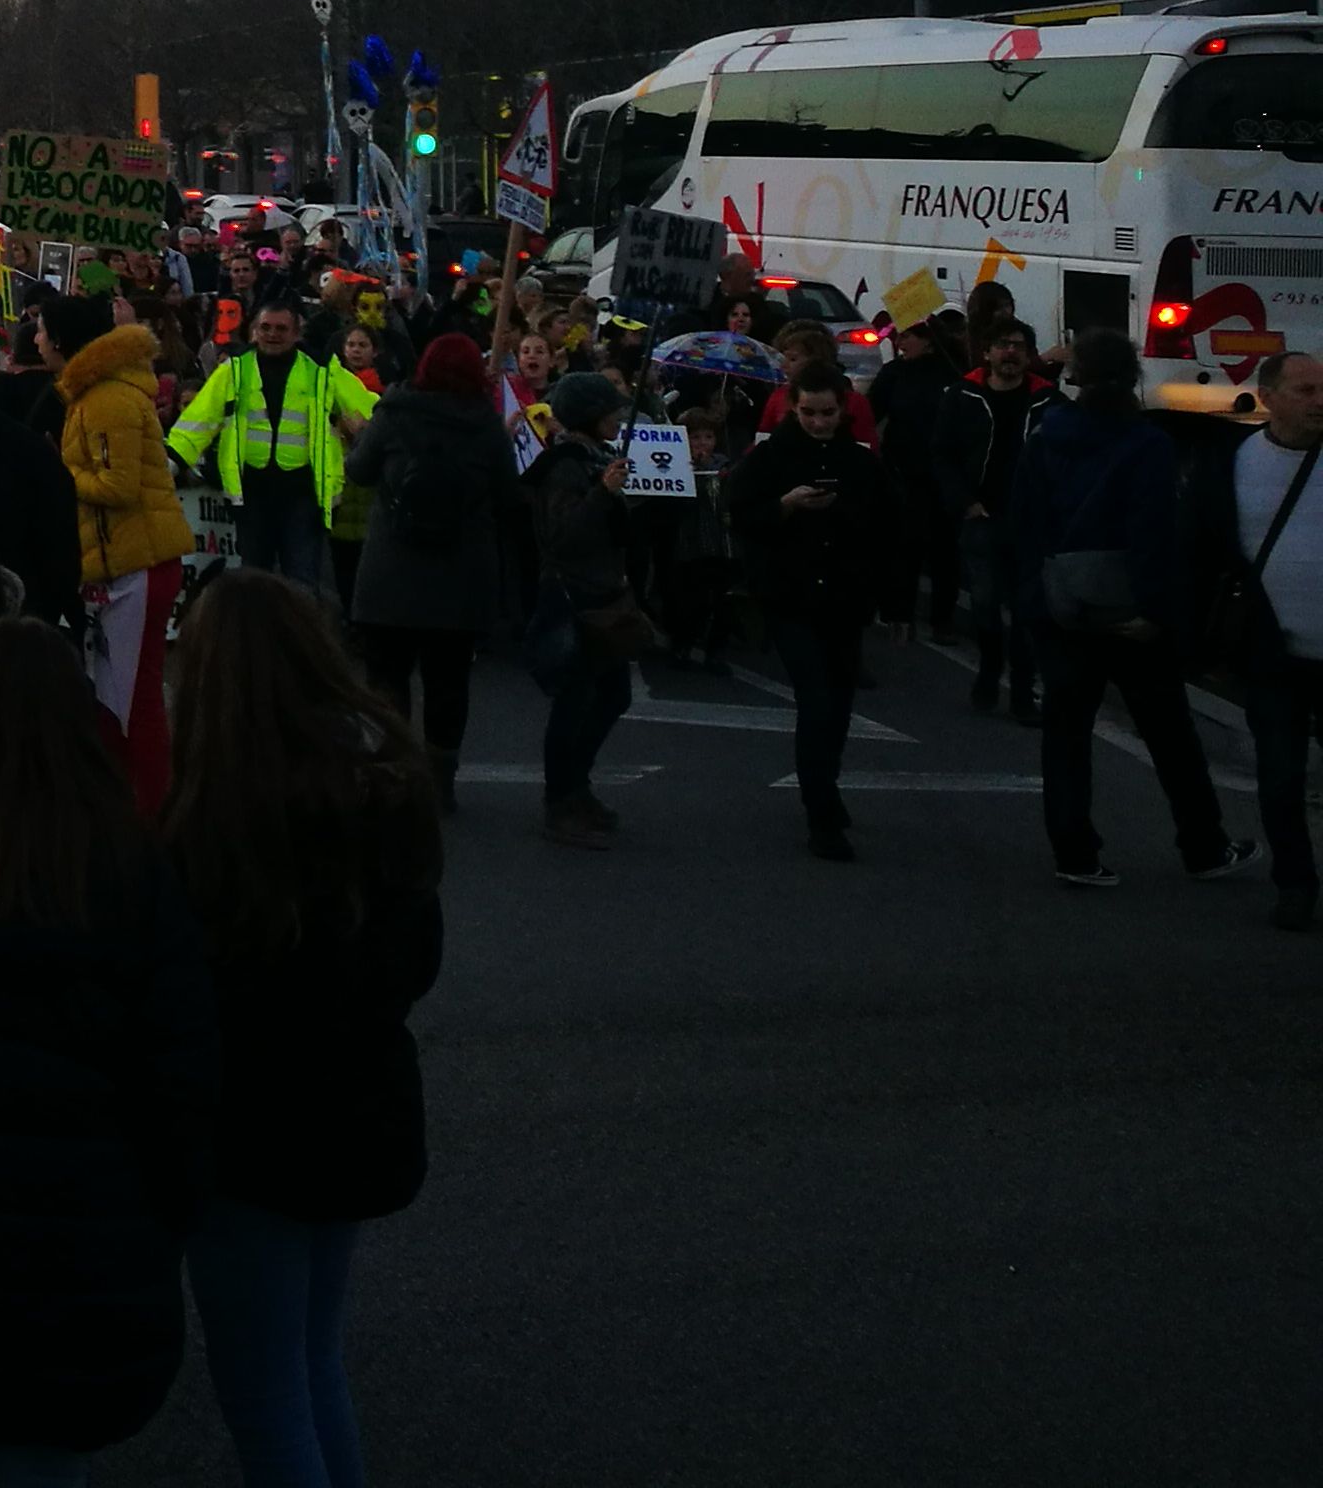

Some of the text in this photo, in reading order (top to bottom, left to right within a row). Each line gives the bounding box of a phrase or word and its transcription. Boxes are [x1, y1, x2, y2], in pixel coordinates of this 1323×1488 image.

[9, 135, 110, 171] NO A
[7, 170, 165, 213] L'ABOCADOR
[901, 184, 1070, 228] FRANQUESA
[1213, 188, 1323, 215] FRAN
[1, 205, 31, 230] DE
[33, 207, 76, 234] CAN
[622, 429, 682, 443] FORMA
